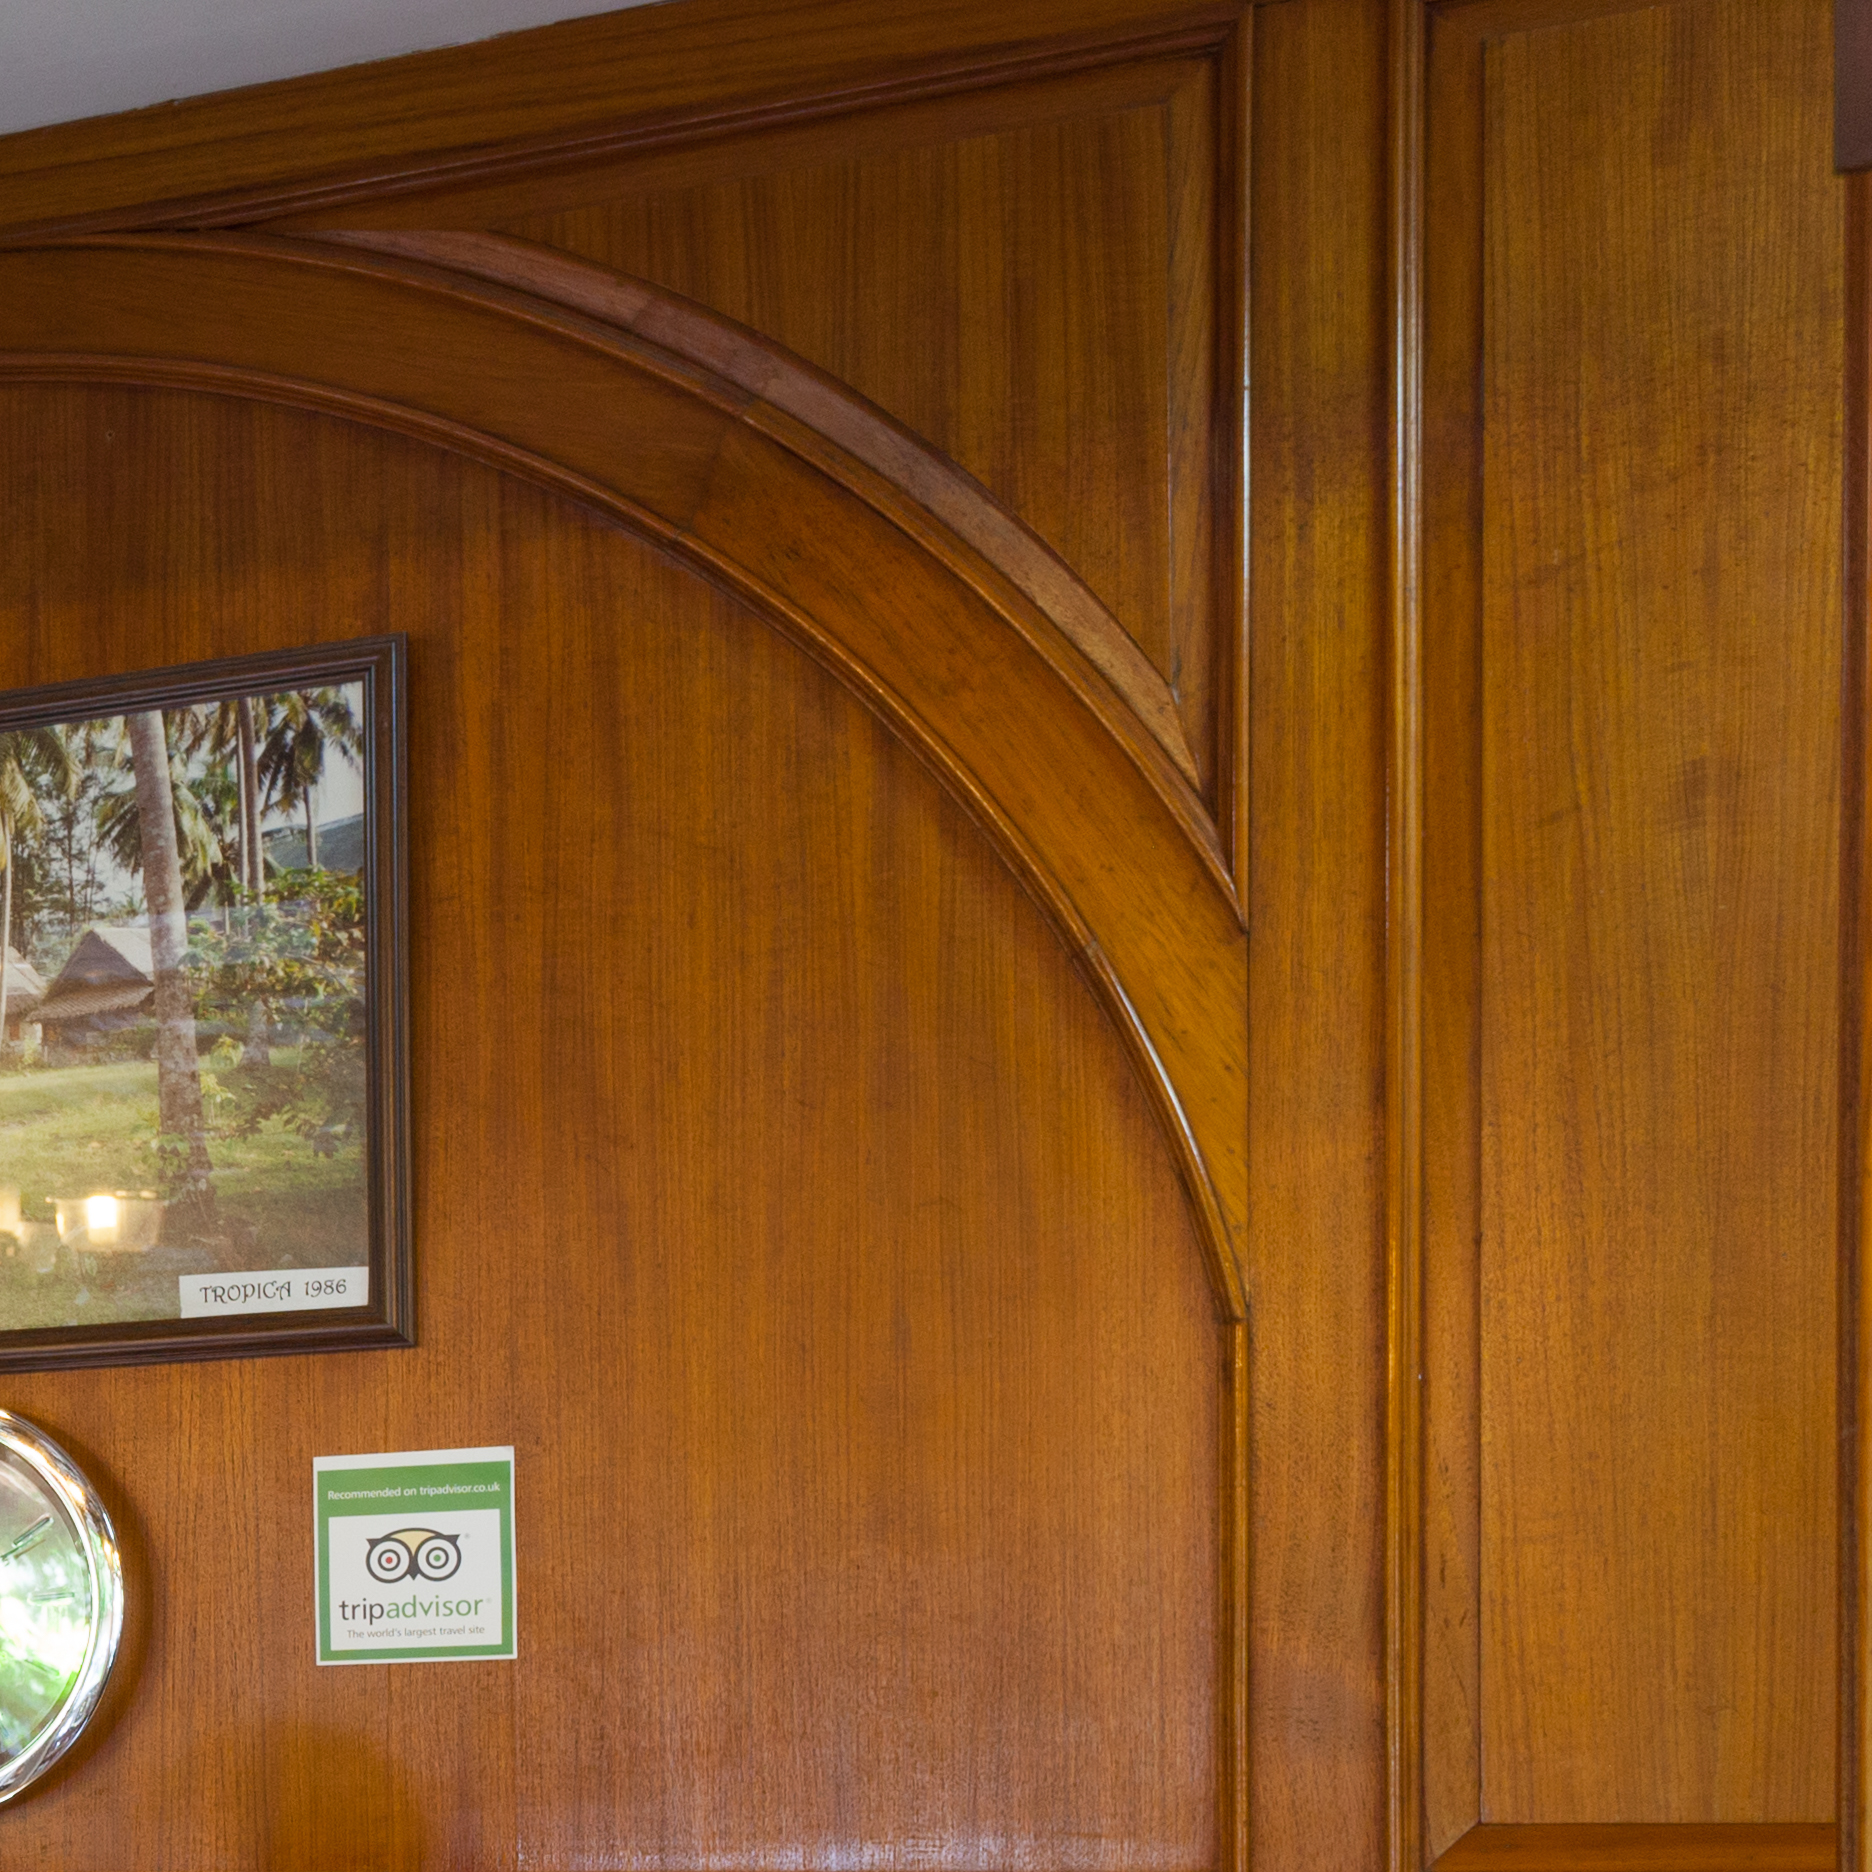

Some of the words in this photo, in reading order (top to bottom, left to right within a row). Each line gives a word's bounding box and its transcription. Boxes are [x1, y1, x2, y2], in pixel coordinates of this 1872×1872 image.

[199, 1280, 292, 1304] TROPICA
[304, 1278, 348, 1298] 1986
[327, 1485, 401, 1500] Recommended
[403, 1487, 417, 1496] on
[419, 1481, 501, 1498] tripadvisor.co.uk
[339, 1594, 484, 1626] tripadvisor
[347, 1629, 365, 1639] The
[367, 1627, 401, 1638] world's
[404, 1626, 437, 1639] largest
[439, 1625, 466, 1635] travel
[468, 1624, 485, 1634] site
